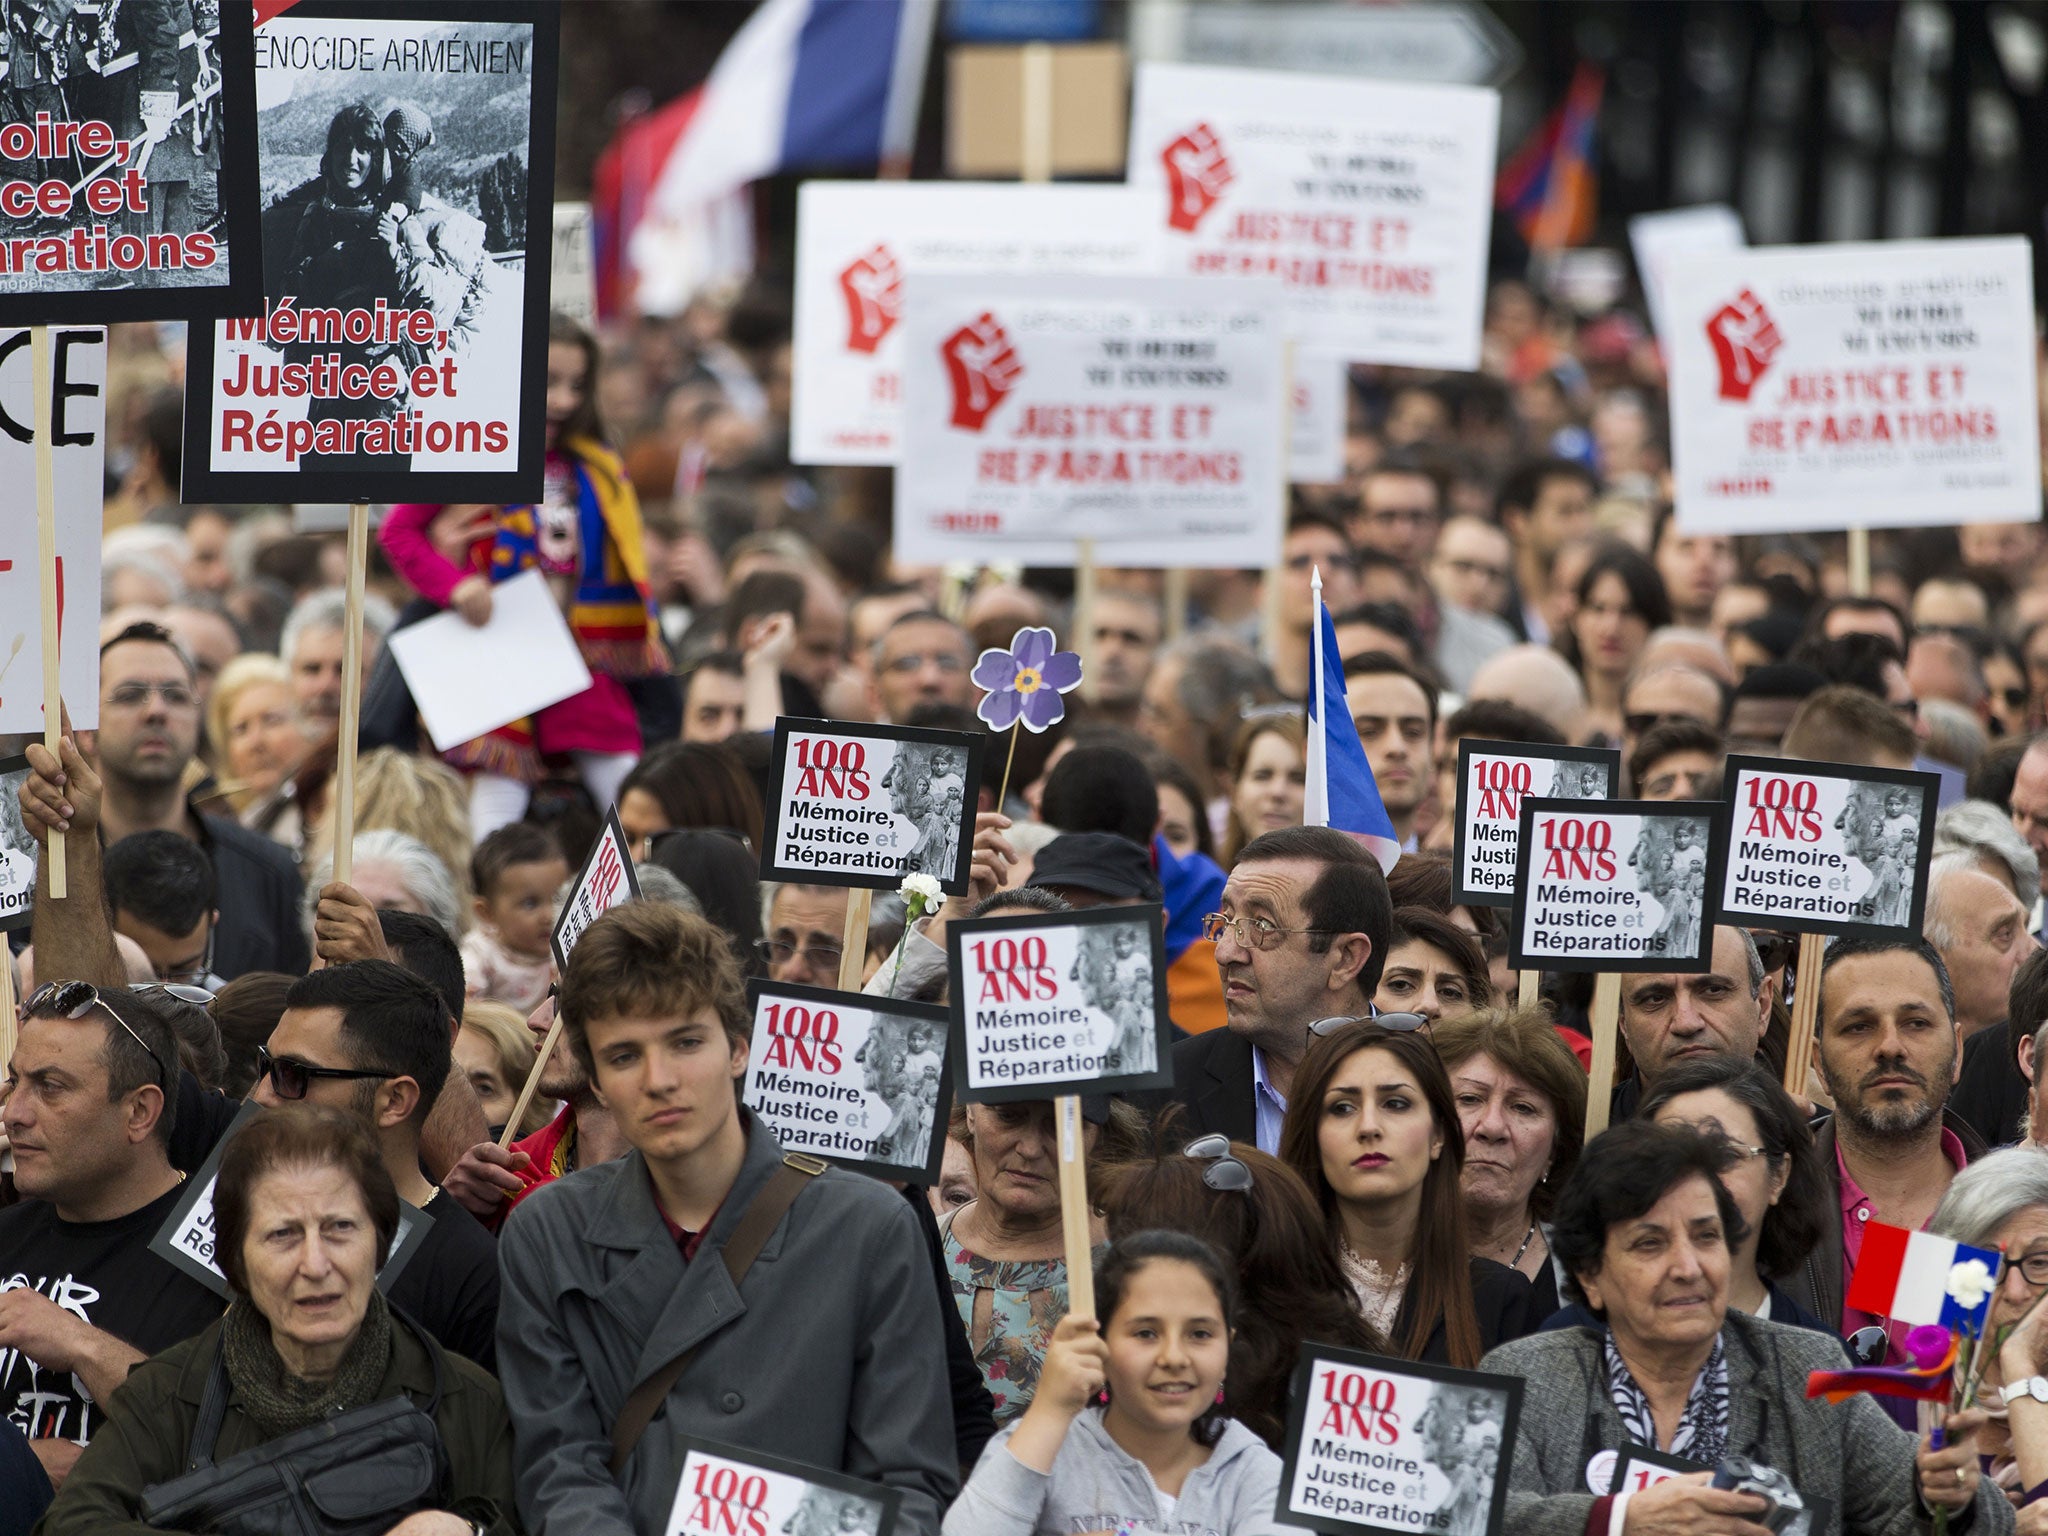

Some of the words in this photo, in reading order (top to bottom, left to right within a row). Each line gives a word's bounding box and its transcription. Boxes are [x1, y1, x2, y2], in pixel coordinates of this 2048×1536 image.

[383, 33, 524, 73] ARMÉNIEN
[86, 169, 148, 214] et
[0, 225, 216, 274] rations
[225, 296, 449, 352] Mémoire,
[221, 353, 400, 398] Justice
[410, 357, 458, 398] et
[1775, 369, 1911, 403] JUSTICE
[1927, 365, 1967, 398] ET
[220, 409, 510, 462] Réparations
[1011, 405, 1155, 440] JUSTICE
[1172, 405, 1212, 440] ET
[794, 739, 865, 772] 100
[795, 767, 870, 800] ANS
[1474, 761, 1531, 791] 100
[1477, 789, 1536, 820] AN
[1745, 777, 1817, 813] 100
[790, 801, 895, 828] Mémoire,
[1745, 806, 1822, 842] ANS
[787, 823, 869, 845] Justice
[875, 831, 898, 848] et
[1540, 819, 1611, 851] 100
[599, 837, 621, 895] 100
[785, 845, 921, 871] Réparations
[1542, 848, 1616, 881] ANS
[1739, 842, 1847, 872] Mémoire,
[1737, 865, 1821, 888] Justice
[1828, 875, 1851, 891] et
[1537, 885, 1641, 908] Mémoire,
[1734, 887, 1874, 916] Réparations
[1534, 908, 1616, 928] Justice
[1623, 911, 1644, 928] et
[970, 937, 1046, 974] 100
[1533, 930, 1666, 953] Réparations
[980, 966, 1058, 1004] ANS
[765, 1004, 838, 1044] 100
[977, 1007, 1088, 1030] Mémoire,
[763, 1035, 843, 1075] ANS
[978, 1033, 1065, 1054] Justice
[1073, 1030, 1095, 1046] et
[979, 1053, 1121, 1080] Réparations
[756, 1071, 865, 1108] Mémoire,
[752, 1096, 838, 1124] Justice
[845, 1110, 869, 1129] et
[1320, 1370, 1396, 1412] 100
[1319, 1402, 1400, 1445] ANS
[1311, 1439, 1424, 1480] Mémoire,
[693, 1463, 768, 1509] 100
[1307, 1464, 1395, 1495] Justice
[1403, 1482, 1427, 1501] et
[1303, 1487, 1450, 1528] Réparations
